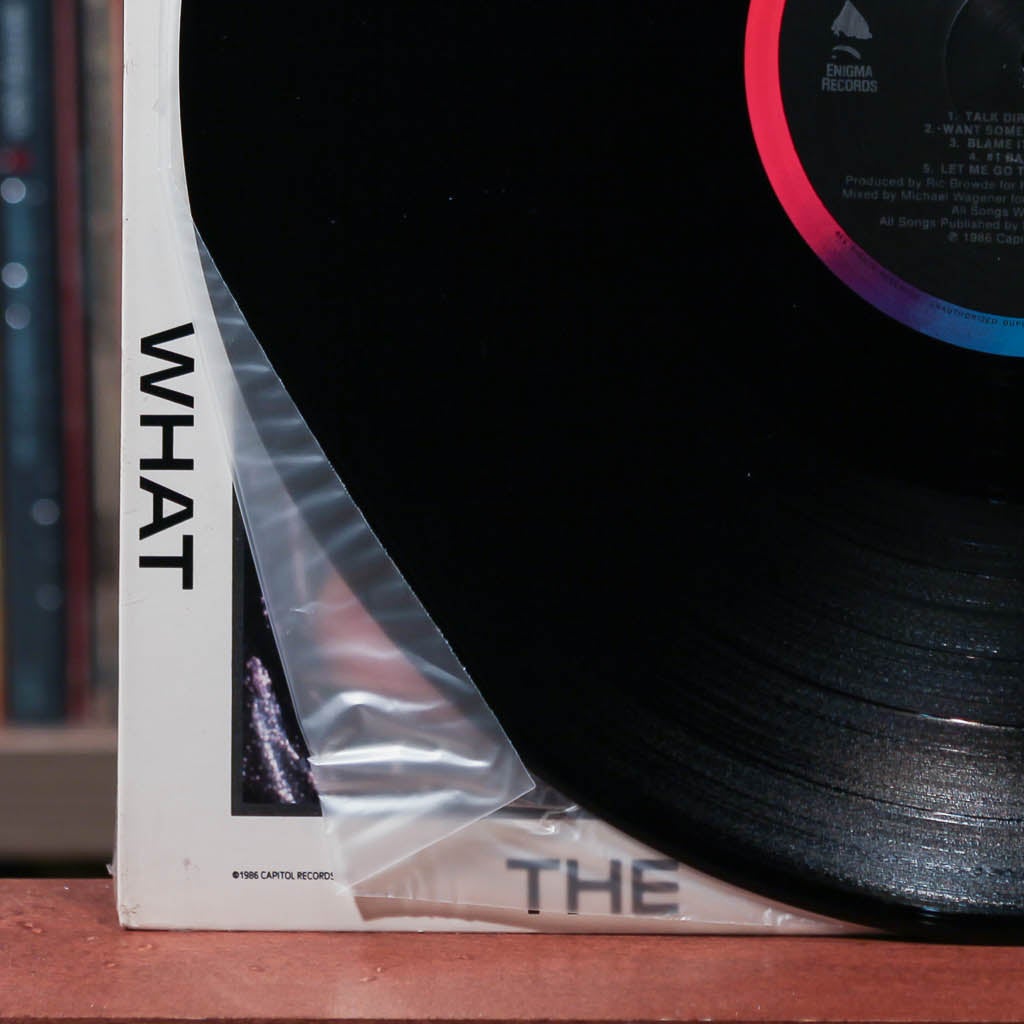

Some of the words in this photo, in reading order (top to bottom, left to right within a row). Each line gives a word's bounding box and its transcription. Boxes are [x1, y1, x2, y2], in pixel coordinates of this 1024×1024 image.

[826, 63, 873, 78] ENIGMA
[821, 76, 879, 93] RECORDS
[965, 112, 999, 122] TALK
[943, 123, 981, 135] WANT
[967, 138, 1013, 150] BLAME
[940, 163, 965, 175] LET
[968, 164, 989, 176] ME
[992, 165, 1014, 177] GO
[845, 175, 904, 187] Produced
[907, 176, 922, 190] by
[999, 179, 1017, 190] for
[842, 188, 879, 200] Mixed
[882, 189, 897, 203] by
[901, 189, 948, 201] Michael
[952, 204, 967, 215] All
[970, 205, 1008, 219] Songs
[879, 215, 895, 226] All
[898, 216, 937, 231] Songs
[940, 217, 1000, 230] Published
[1004, 219, 1019, 233] by
[963, 232, 993, 244] 1986
[139, 322, 195, 590] WHAT
[260, 871, 295, 880] CAPITOL
[506, 858, 679, 914] THE
